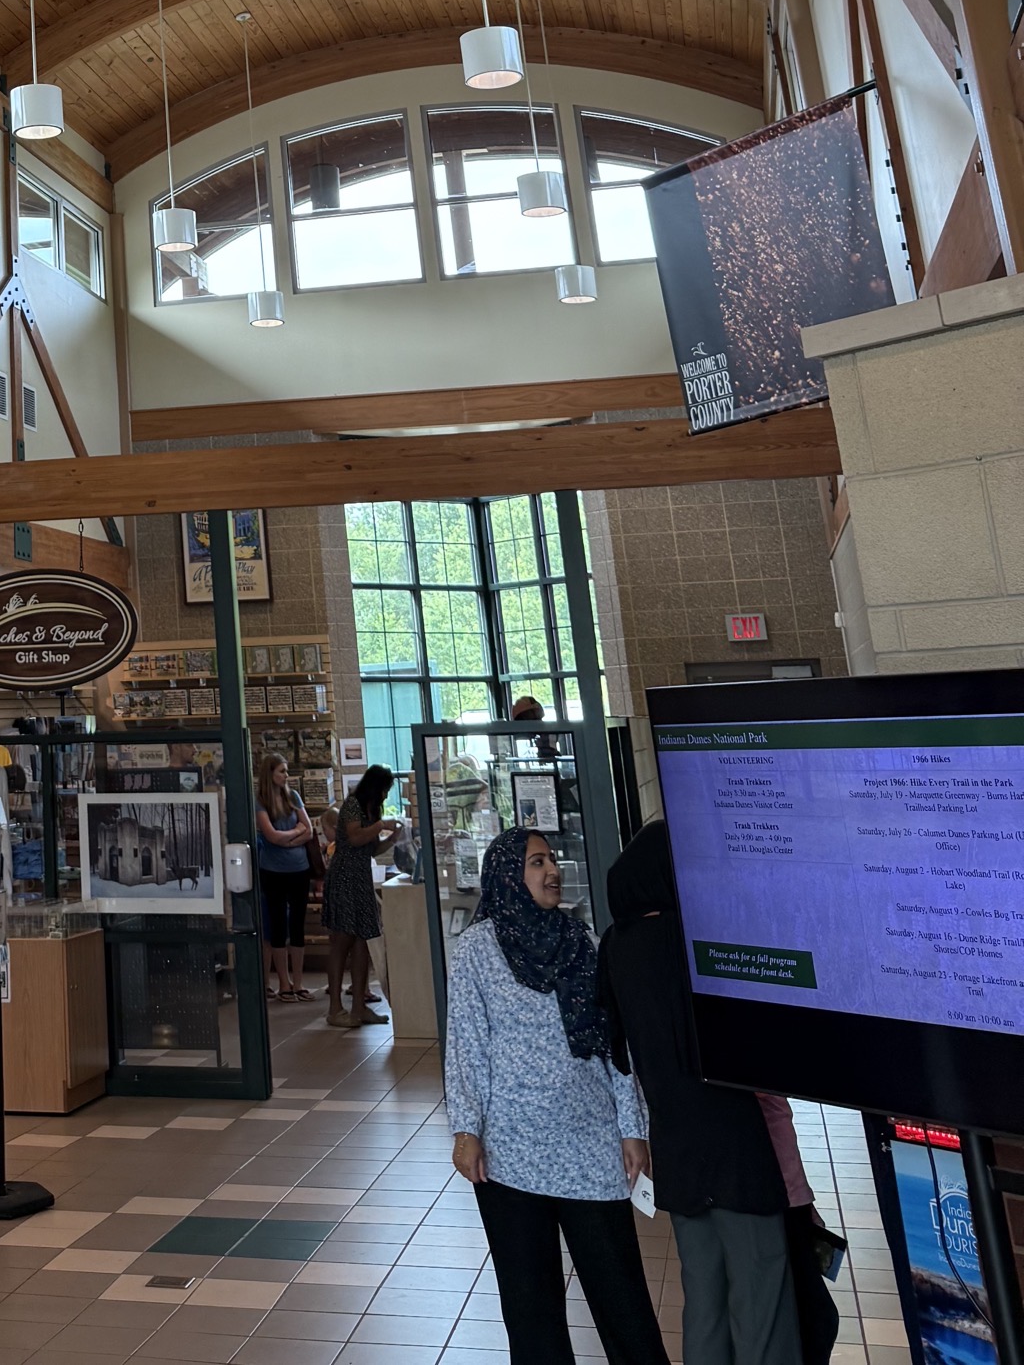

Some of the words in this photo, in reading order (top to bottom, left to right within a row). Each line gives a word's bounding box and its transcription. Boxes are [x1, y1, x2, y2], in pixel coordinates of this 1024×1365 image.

[680, 355, 717, 379] WELCOME
[716, 352, 728, 369] TO
[684, 370, 733, 404] PORTER
[690, 396, 734, 431] COUNTY
[32, 626, 46, 642] &
[50, 622, 109, 648] Beyond
[731, 616, 761, 640] EXIT
[15, 651, 38, 664] Gift
[42, 650, 70, 664] Shop
[658, 735, 686, 745] Indiana
[687, 734, 711, 744] Dunes
[713, 733, 747, 744] National
[748, 732, 768, 743] Park
[719, 757, 774, 765] VOLUNTEERING
[912, 755, 928, 763] 1966
[930, 755, 951, 763] Hikes
[728, 778, 744, 786] Trash
[746, 778, 772, 786] Trekkers
[864, 778, 888, 788] Project
[890, 778, 908, 786] 1966:
[910, 778, 927, 786] Hike
[928, 779, 950, 788] Every
[951, 778, 970, 787] Trail
[972, 779, 979, 787] in
[980, 779, 993, 787] the
[994, 779, 1014, 787] Park
[849, 790, 879, 800] Saturday,
[880, 791, 893, 800] July
[909, 791, 943, 801] Marquette
[945, 792, 980, 801] Greenway
[774, 801, 793, 809] Center
[904, 803, 936, 812] Trailhead
[937, 804, 965, 814] Parking
[752, 822, 780, 831] Trekkers
[857, 827, 887, 837] Saturday,
[888, 828, 902, 837] July
[918, 829, 946, 838] Calumet
[948, 830, 970, 838] Dunes
[972, 830, 1000, 841] Parking
[774, 846, 793, 854] Center
[935, 842, 961, 852] Office)
[864, 864, 894, 875] Saturday,
[895, 865, 919, 876] August
[930, 867, 954, 877] Hobart
[956, 868, 991, 878] Woodland
[994, 870, 1010, 879] Trail
[896, 903, 927, 914] Saturday,
[929, 905, 953, 916] August
[966, 908, 993, 918] Cowles
[994, 910, 1010, 921] Bog
[885, 927, 917, 939] Saturday,
[918, 931, 941, 941] August
[979, 935, 1001, 946] Ridge
[709, 949, 727, 958] Please
[729, 952, 739, 960] ask
[741, 952, 750, 962] for
[756, 954, 768, 963] full
[770, 957, 797, 967] program
[977, 948, 1003, 959] Homes
[715, 963, 741, 972] schedule
[750, 966, 759, 974] the
[760, 967, 777, 977] front
[881, 965, 912, 977] Saturday,
[913, 968, 937, 980] August
[954, 971, 980, 984] Portage
[982, 975, 1017, 987] Lakefront
[966, 987, 984, 997] Trail
[929, 1198, 977, 1239] Dune
[935, 1231, 979, 1256] TOURIS
